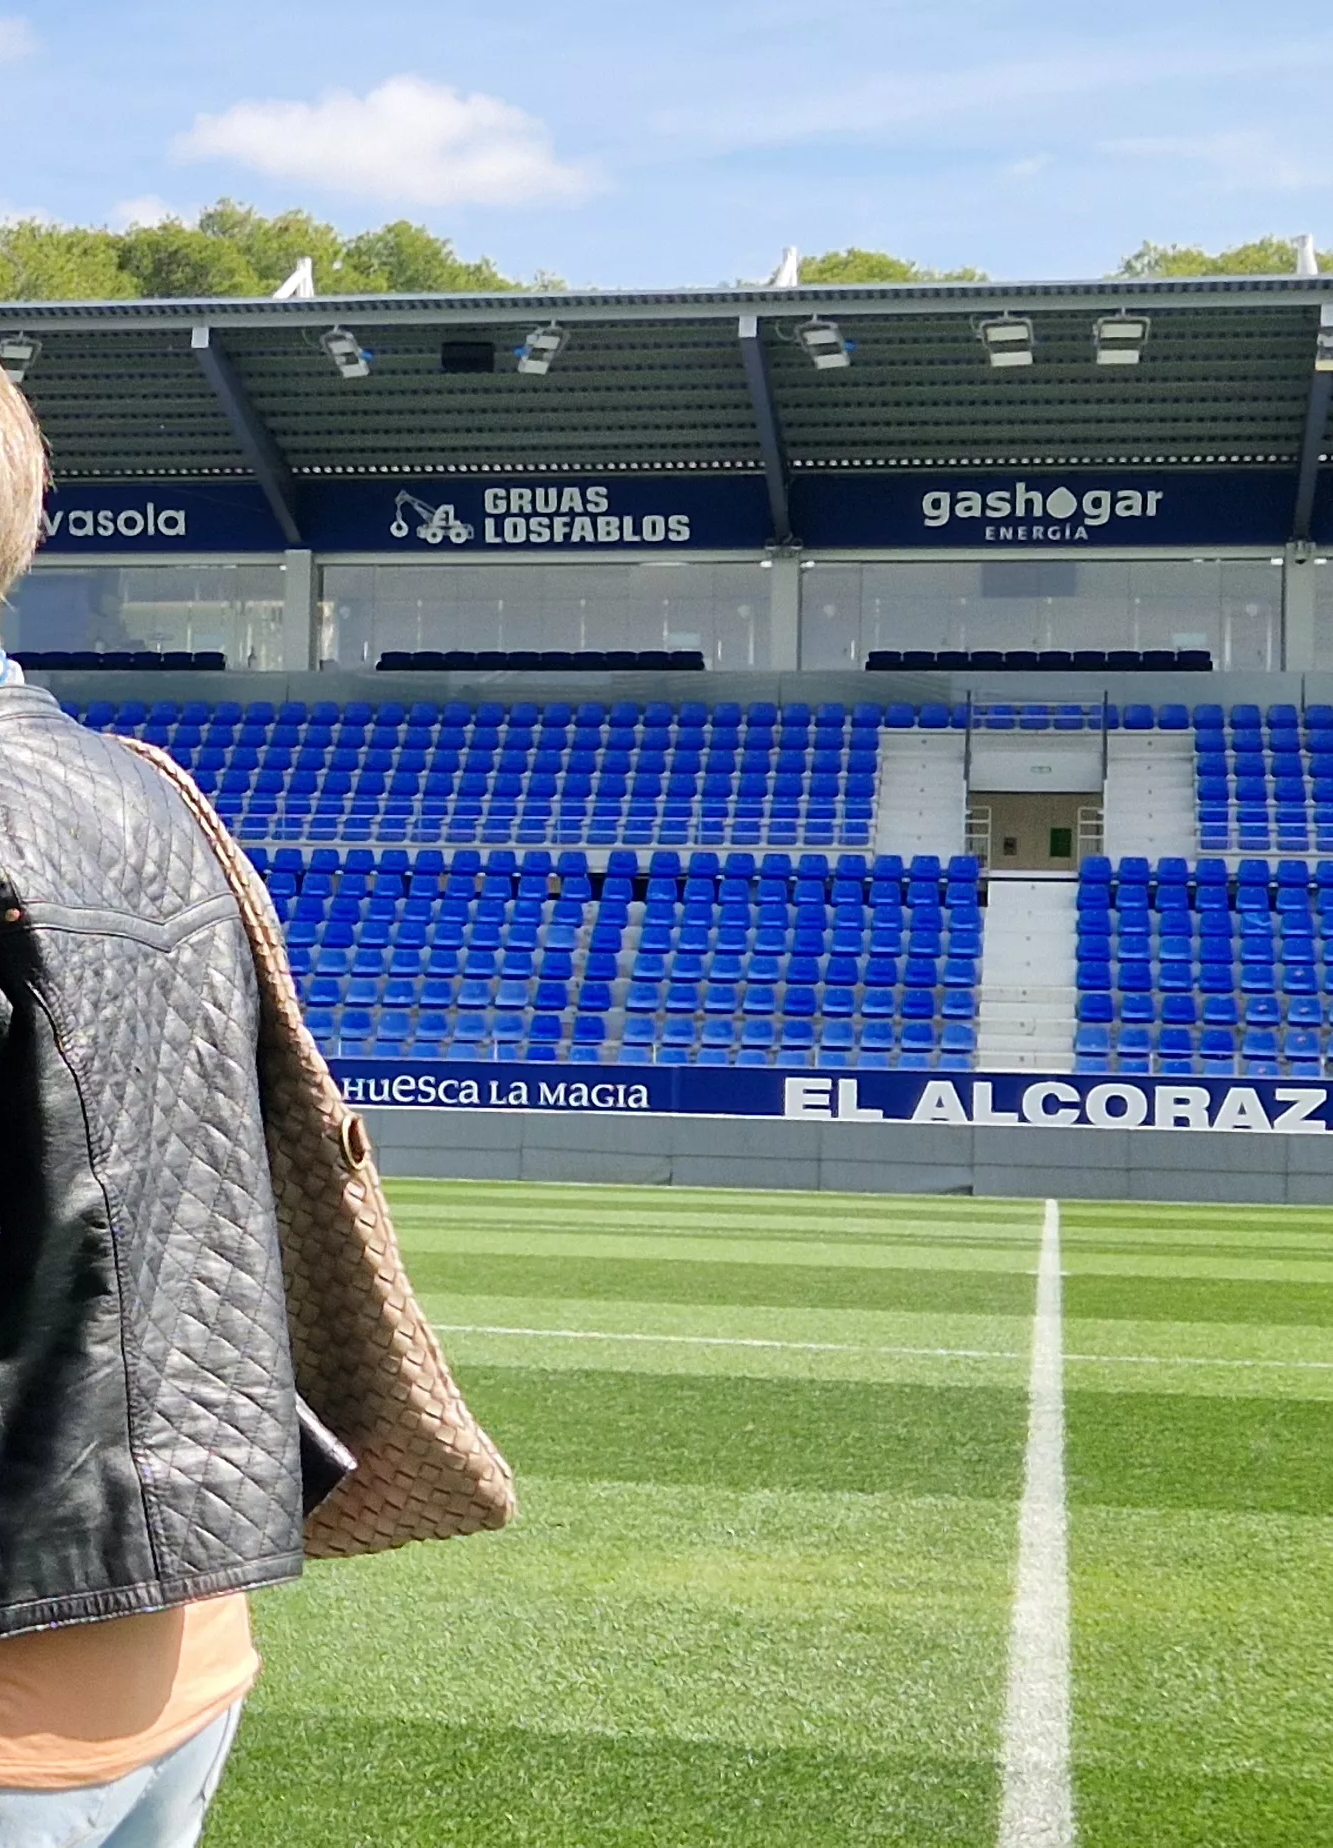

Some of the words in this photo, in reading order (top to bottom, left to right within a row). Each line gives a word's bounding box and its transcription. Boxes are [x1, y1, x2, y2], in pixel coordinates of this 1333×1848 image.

[483, 486, 609, 514] GRUAS
[483, 514, 691, 544] LOSFABLOS
[984, 522, 1089, 541] ENERGÍA
[783, 1077, 884, 1119] EL
[910, 1079, 1329, 1133] ALCORAZ
